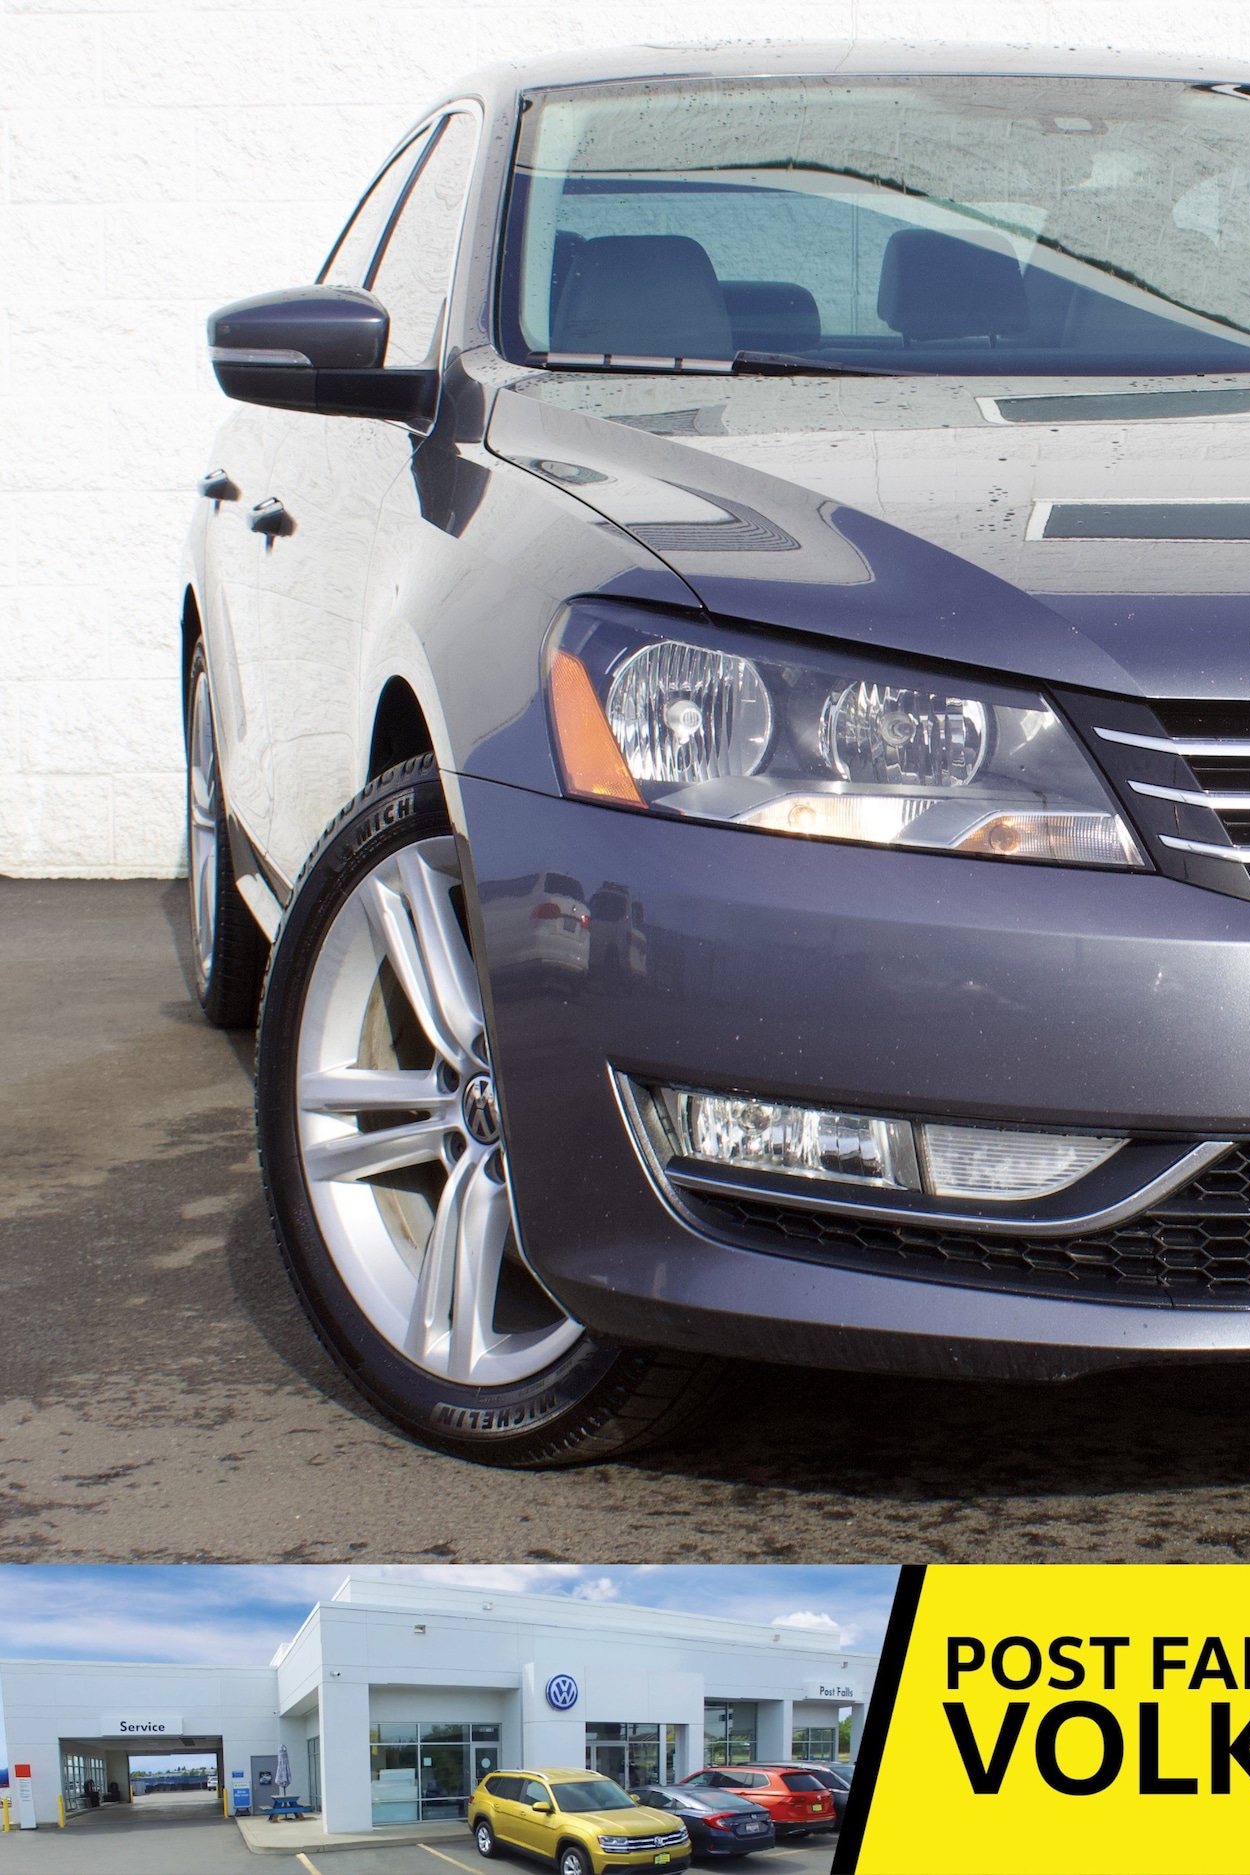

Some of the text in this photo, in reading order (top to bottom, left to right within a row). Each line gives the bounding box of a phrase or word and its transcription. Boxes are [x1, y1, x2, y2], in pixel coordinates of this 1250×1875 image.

[436, 1393, 558, 1430] MICHELIN
[819, 1686, 854, 1698] Post Falls
[120, 1721, 166, 1733] Service
